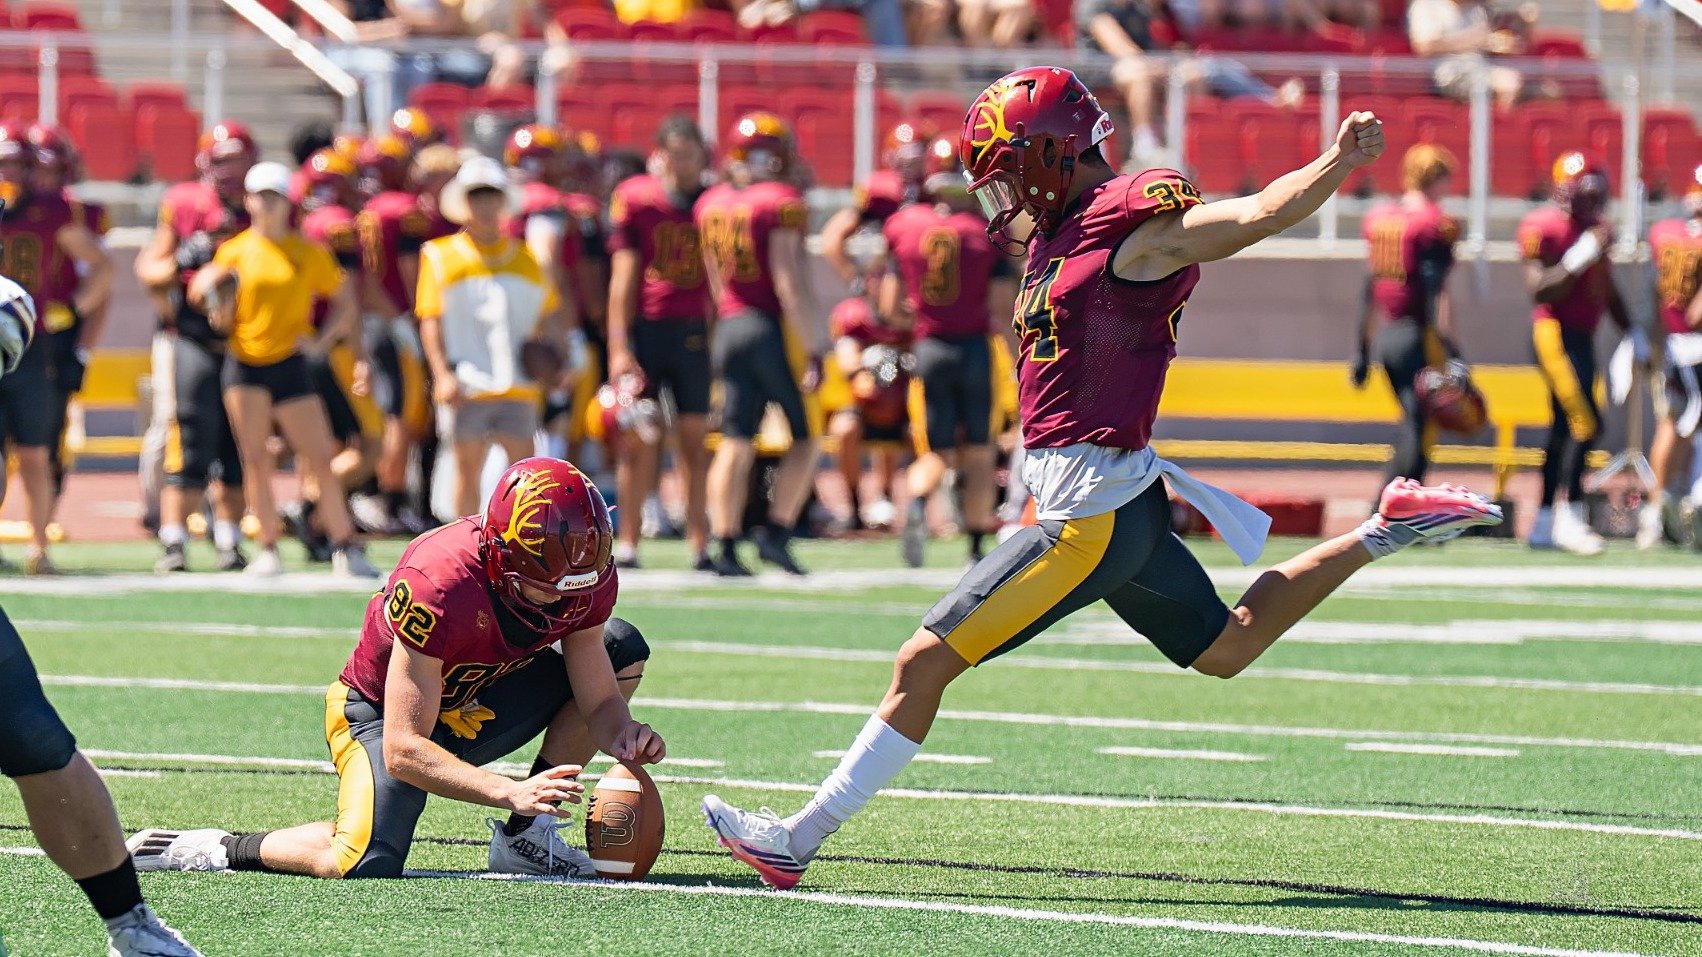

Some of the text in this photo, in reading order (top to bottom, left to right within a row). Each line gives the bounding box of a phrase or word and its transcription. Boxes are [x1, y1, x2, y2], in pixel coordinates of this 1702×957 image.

[1142, 178, 1205, 214] 34
[564, 576, 597, 588] Riddell
[389, 579, 436, 648] 82
